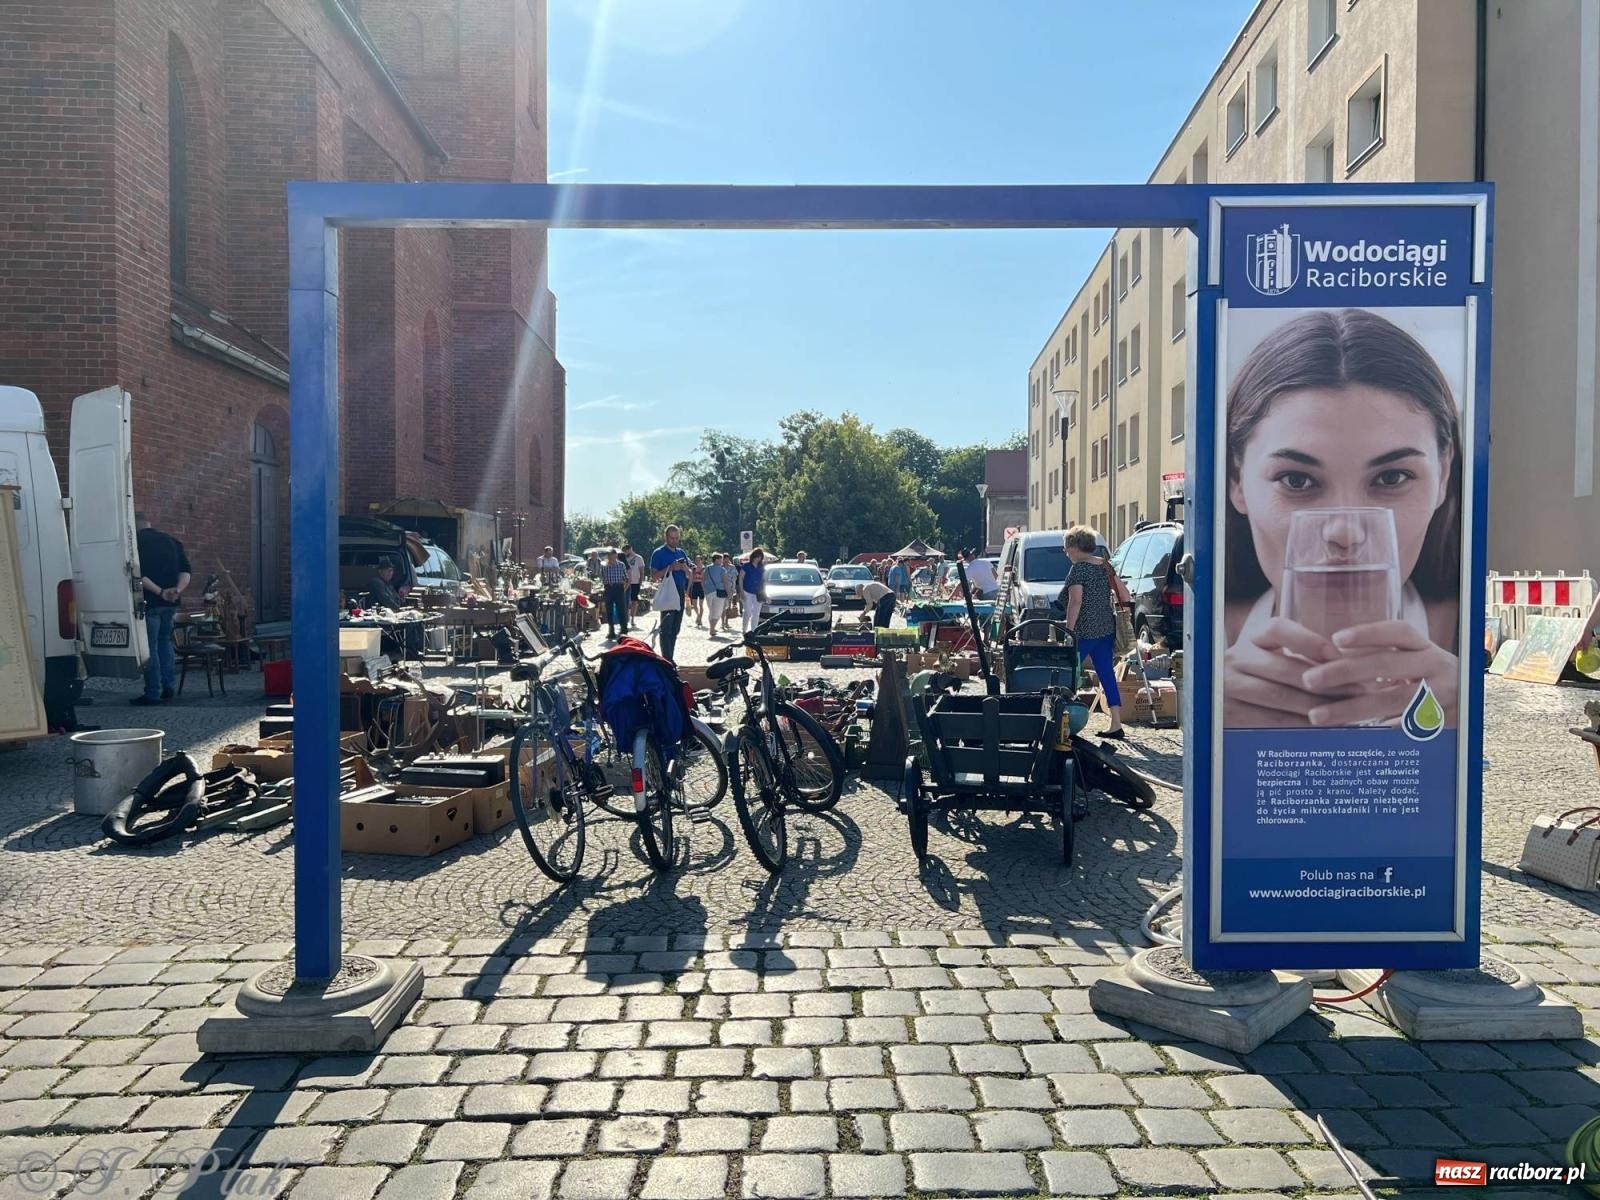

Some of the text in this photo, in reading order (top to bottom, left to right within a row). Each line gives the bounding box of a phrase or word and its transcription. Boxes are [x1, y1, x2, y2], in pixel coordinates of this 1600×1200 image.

[1304, 239, 1447, 267] Wodociągi
[1306, 267, 1447, 288] Raciborskie
[1257, 750, 1266, 758] W
[1268, 749, 1308, 758] Raciborzu
[1310, 751, 1335, 759] mamy
[1347, 748, 1386, 758] szczęście,
[1398, 748, 1420, 756] woda
[1257, 759, 1326, 768] Raciborzanka,
[1331, 759, 1389, 767] dostarczana
[1257, 767, 1420, 778] Wodociągi Raciborskie jest całkowicie
[1257, 778, 1301, 787] bezpieczna
[1312, 778, 1326, 786] bez
[1256, 788, 1265, 797] ją
[1358, 787, 1386, 796] Należy
[1390, 786, 1420, 795] dodać,
[1271, 797, 1330, 805] Raciborzanka
[1334, 796, 1369, 804] zawiera
[1373, 796, 1420, 805] niezbędne
[1256, 806, 1269, 815] do
[1273, 806, 1296, 816] życia
[1301, 805, 1370, 815] mikroskładniki
[1382, 805, 1397, 814] nie
[1401, 805, 1420, 815] jest
[1256, 816, 1307, 825] chlorowana.
[1300, 870, 1333, 881] Polub
[1336, 872, 1357, 881] nas
[1360, 871, 1374, 881] na
[1249, 886, 1426, 900] www.wodociagiraciborskie.pl
